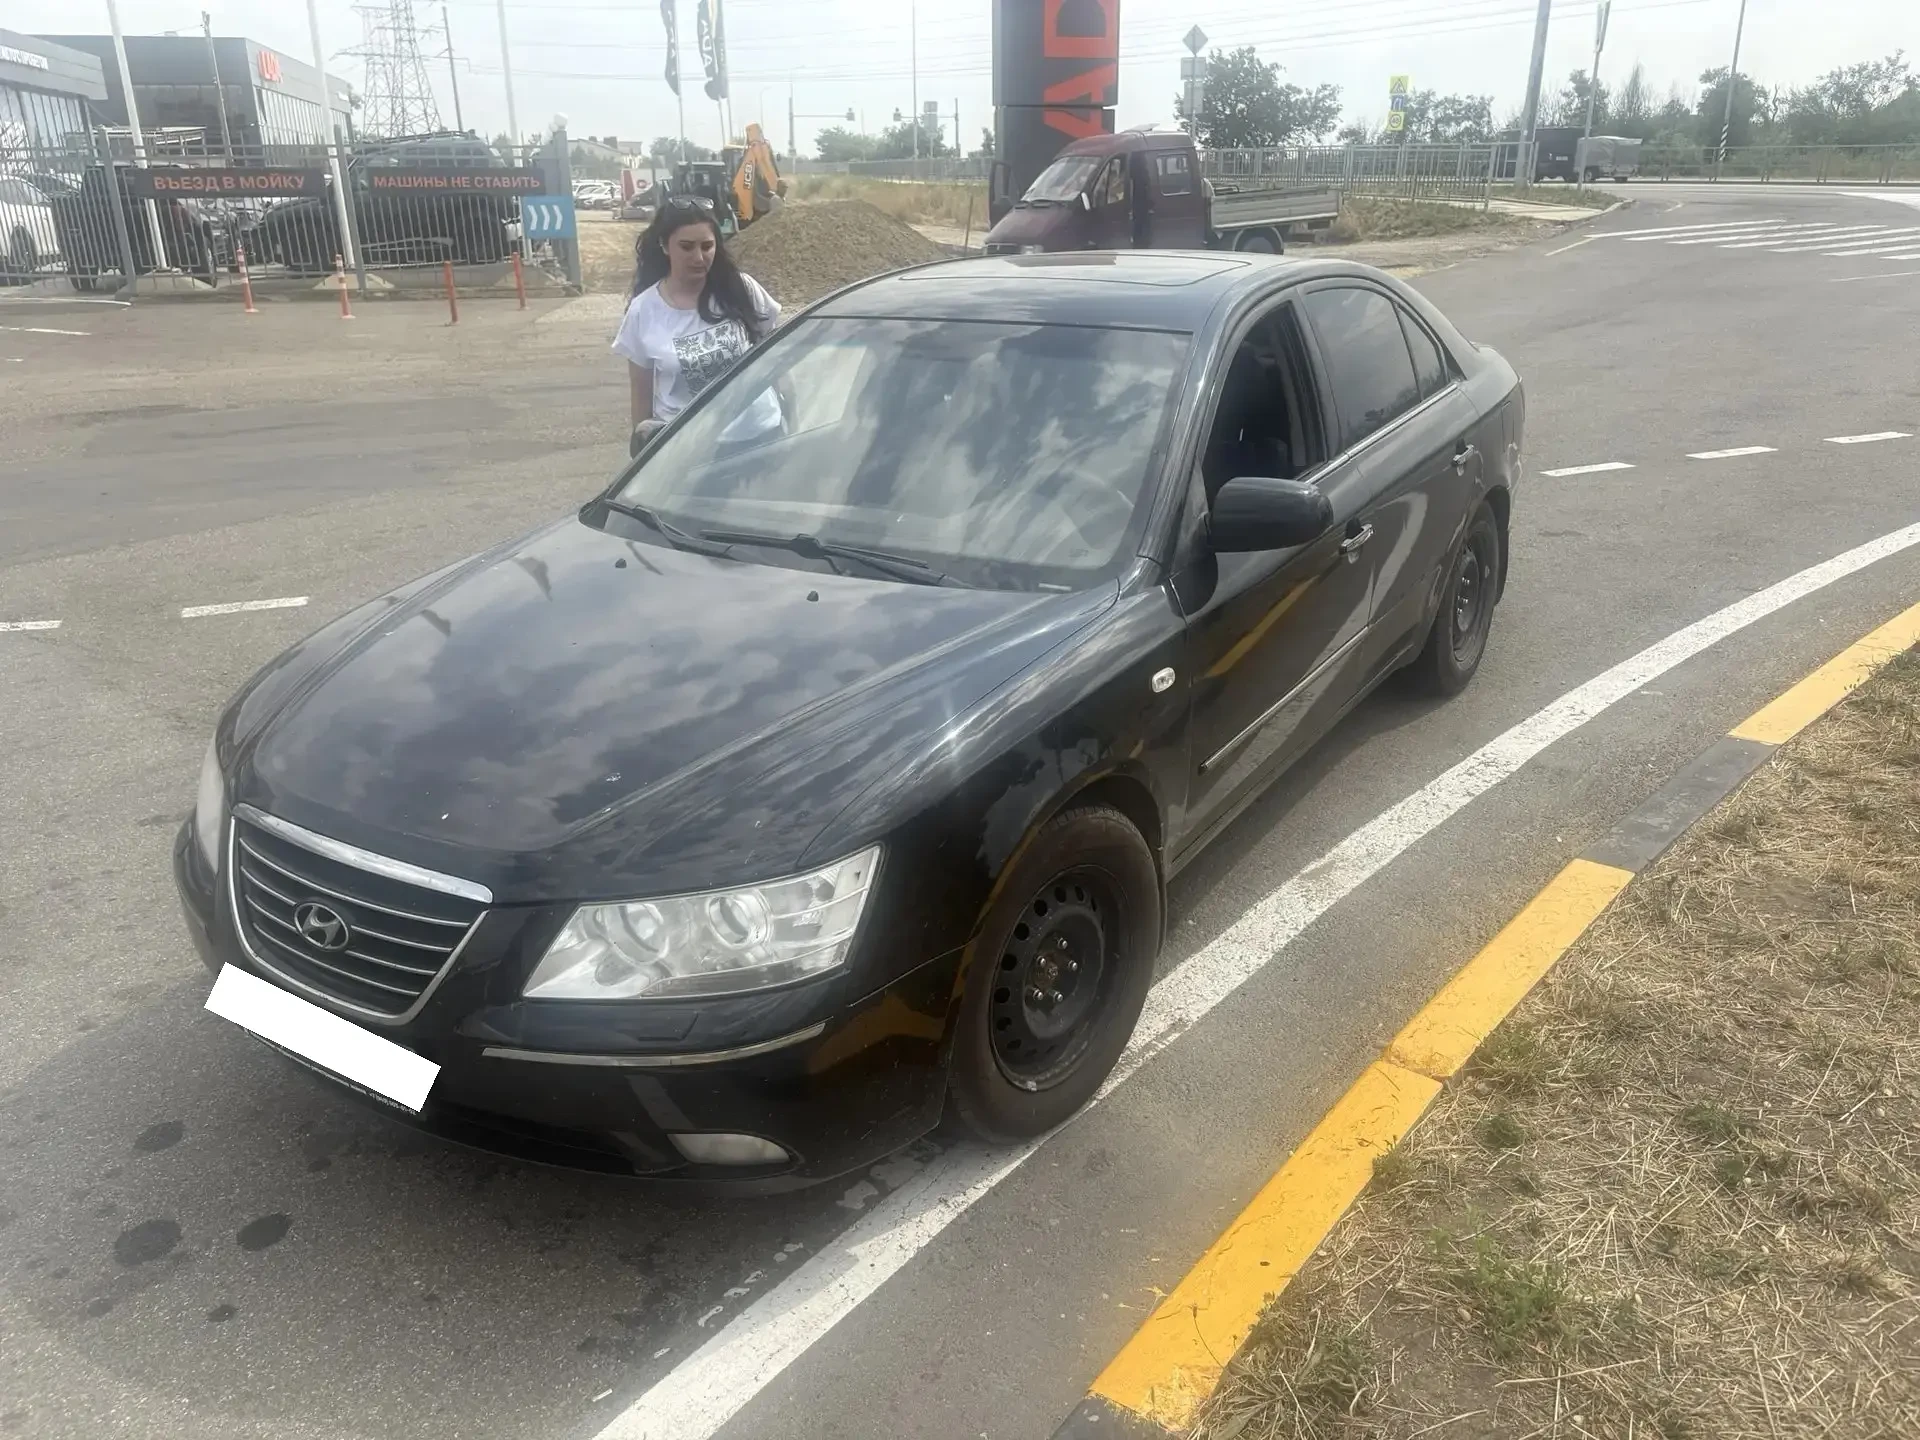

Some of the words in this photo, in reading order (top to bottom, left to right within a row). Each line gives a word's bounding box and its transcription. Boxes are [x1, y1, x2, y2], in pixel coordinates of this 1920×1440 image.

[152, 176, 220, 191] ВЪЕЗД
[221, 176, 236, 189] В
[239, 173, 305, 190] МОЙКУ
[373, 176, 447, 188] МАШИНЫ
[451, 176, 470, 188] НЕ
[474, 176, 540, 189] СТАВИТЬ
[744, 163, 753, 189] JCB
